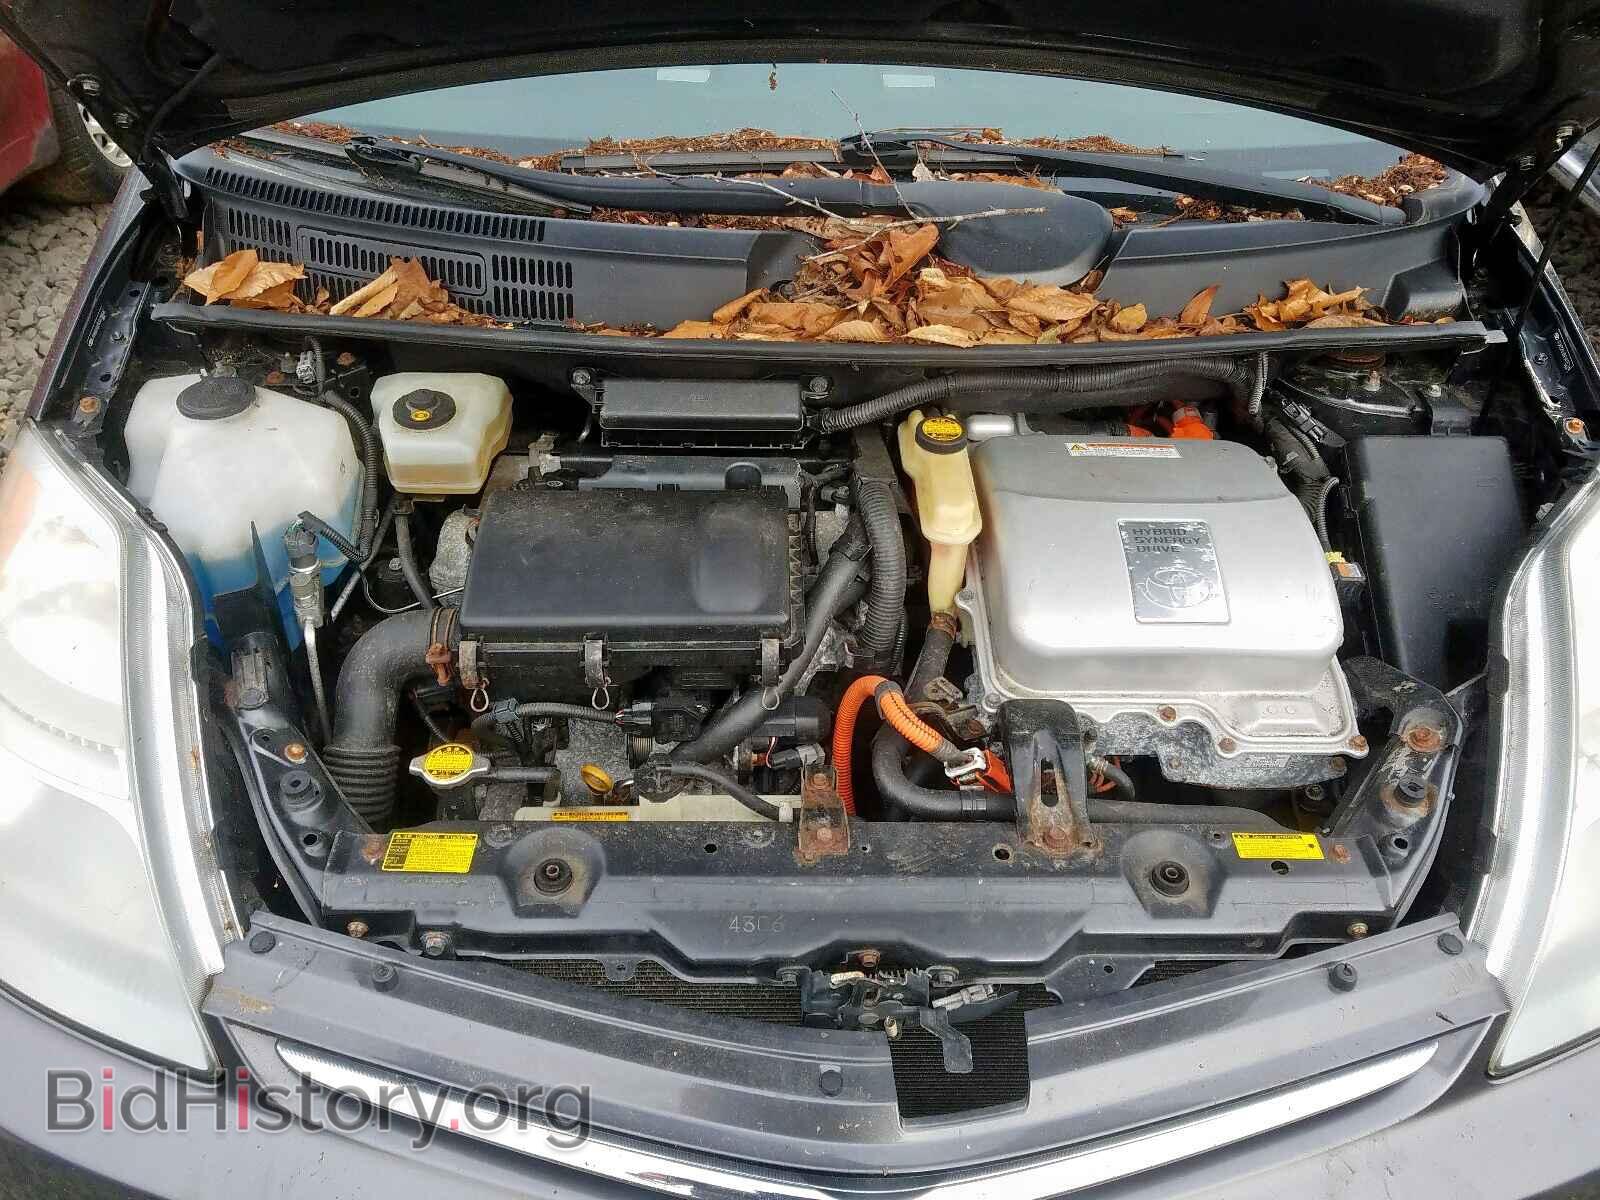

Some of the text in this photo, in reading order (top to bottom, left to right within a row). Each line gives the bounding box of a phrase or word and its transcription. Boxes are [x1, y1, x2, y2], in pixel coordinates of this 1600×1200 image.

[1132, 528, 1187, 536] HYBRID
[1135, 536, 1200, 545] SYNERGY
[1136, 545, 1181, 553] DRIVE
